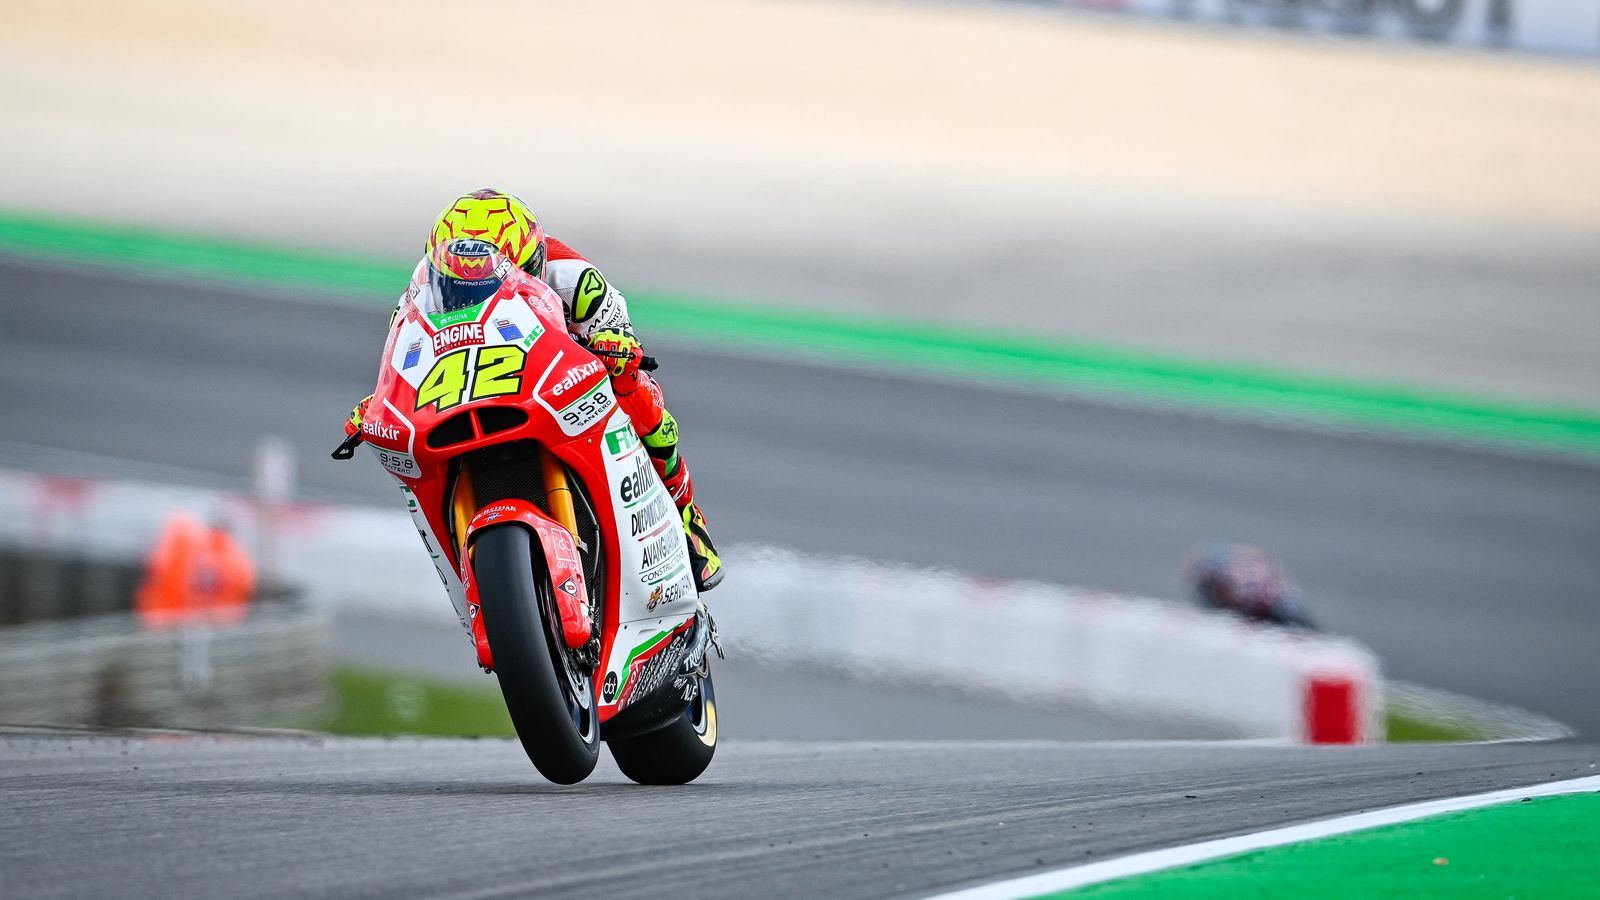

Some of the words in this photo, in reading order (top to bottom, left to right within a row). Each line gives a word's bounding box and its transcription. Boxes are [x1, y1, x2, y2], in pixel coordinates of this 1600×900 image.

[453, 243, 491, 253] HJC
[433, 323, 484, 350] ENGINE
[414, 344, 527, 413] 42
[552, 359, 600, 396] ealixir
[577, 400, 612, 427] SANTERO
[363, 420, 400, 440] ealixir
